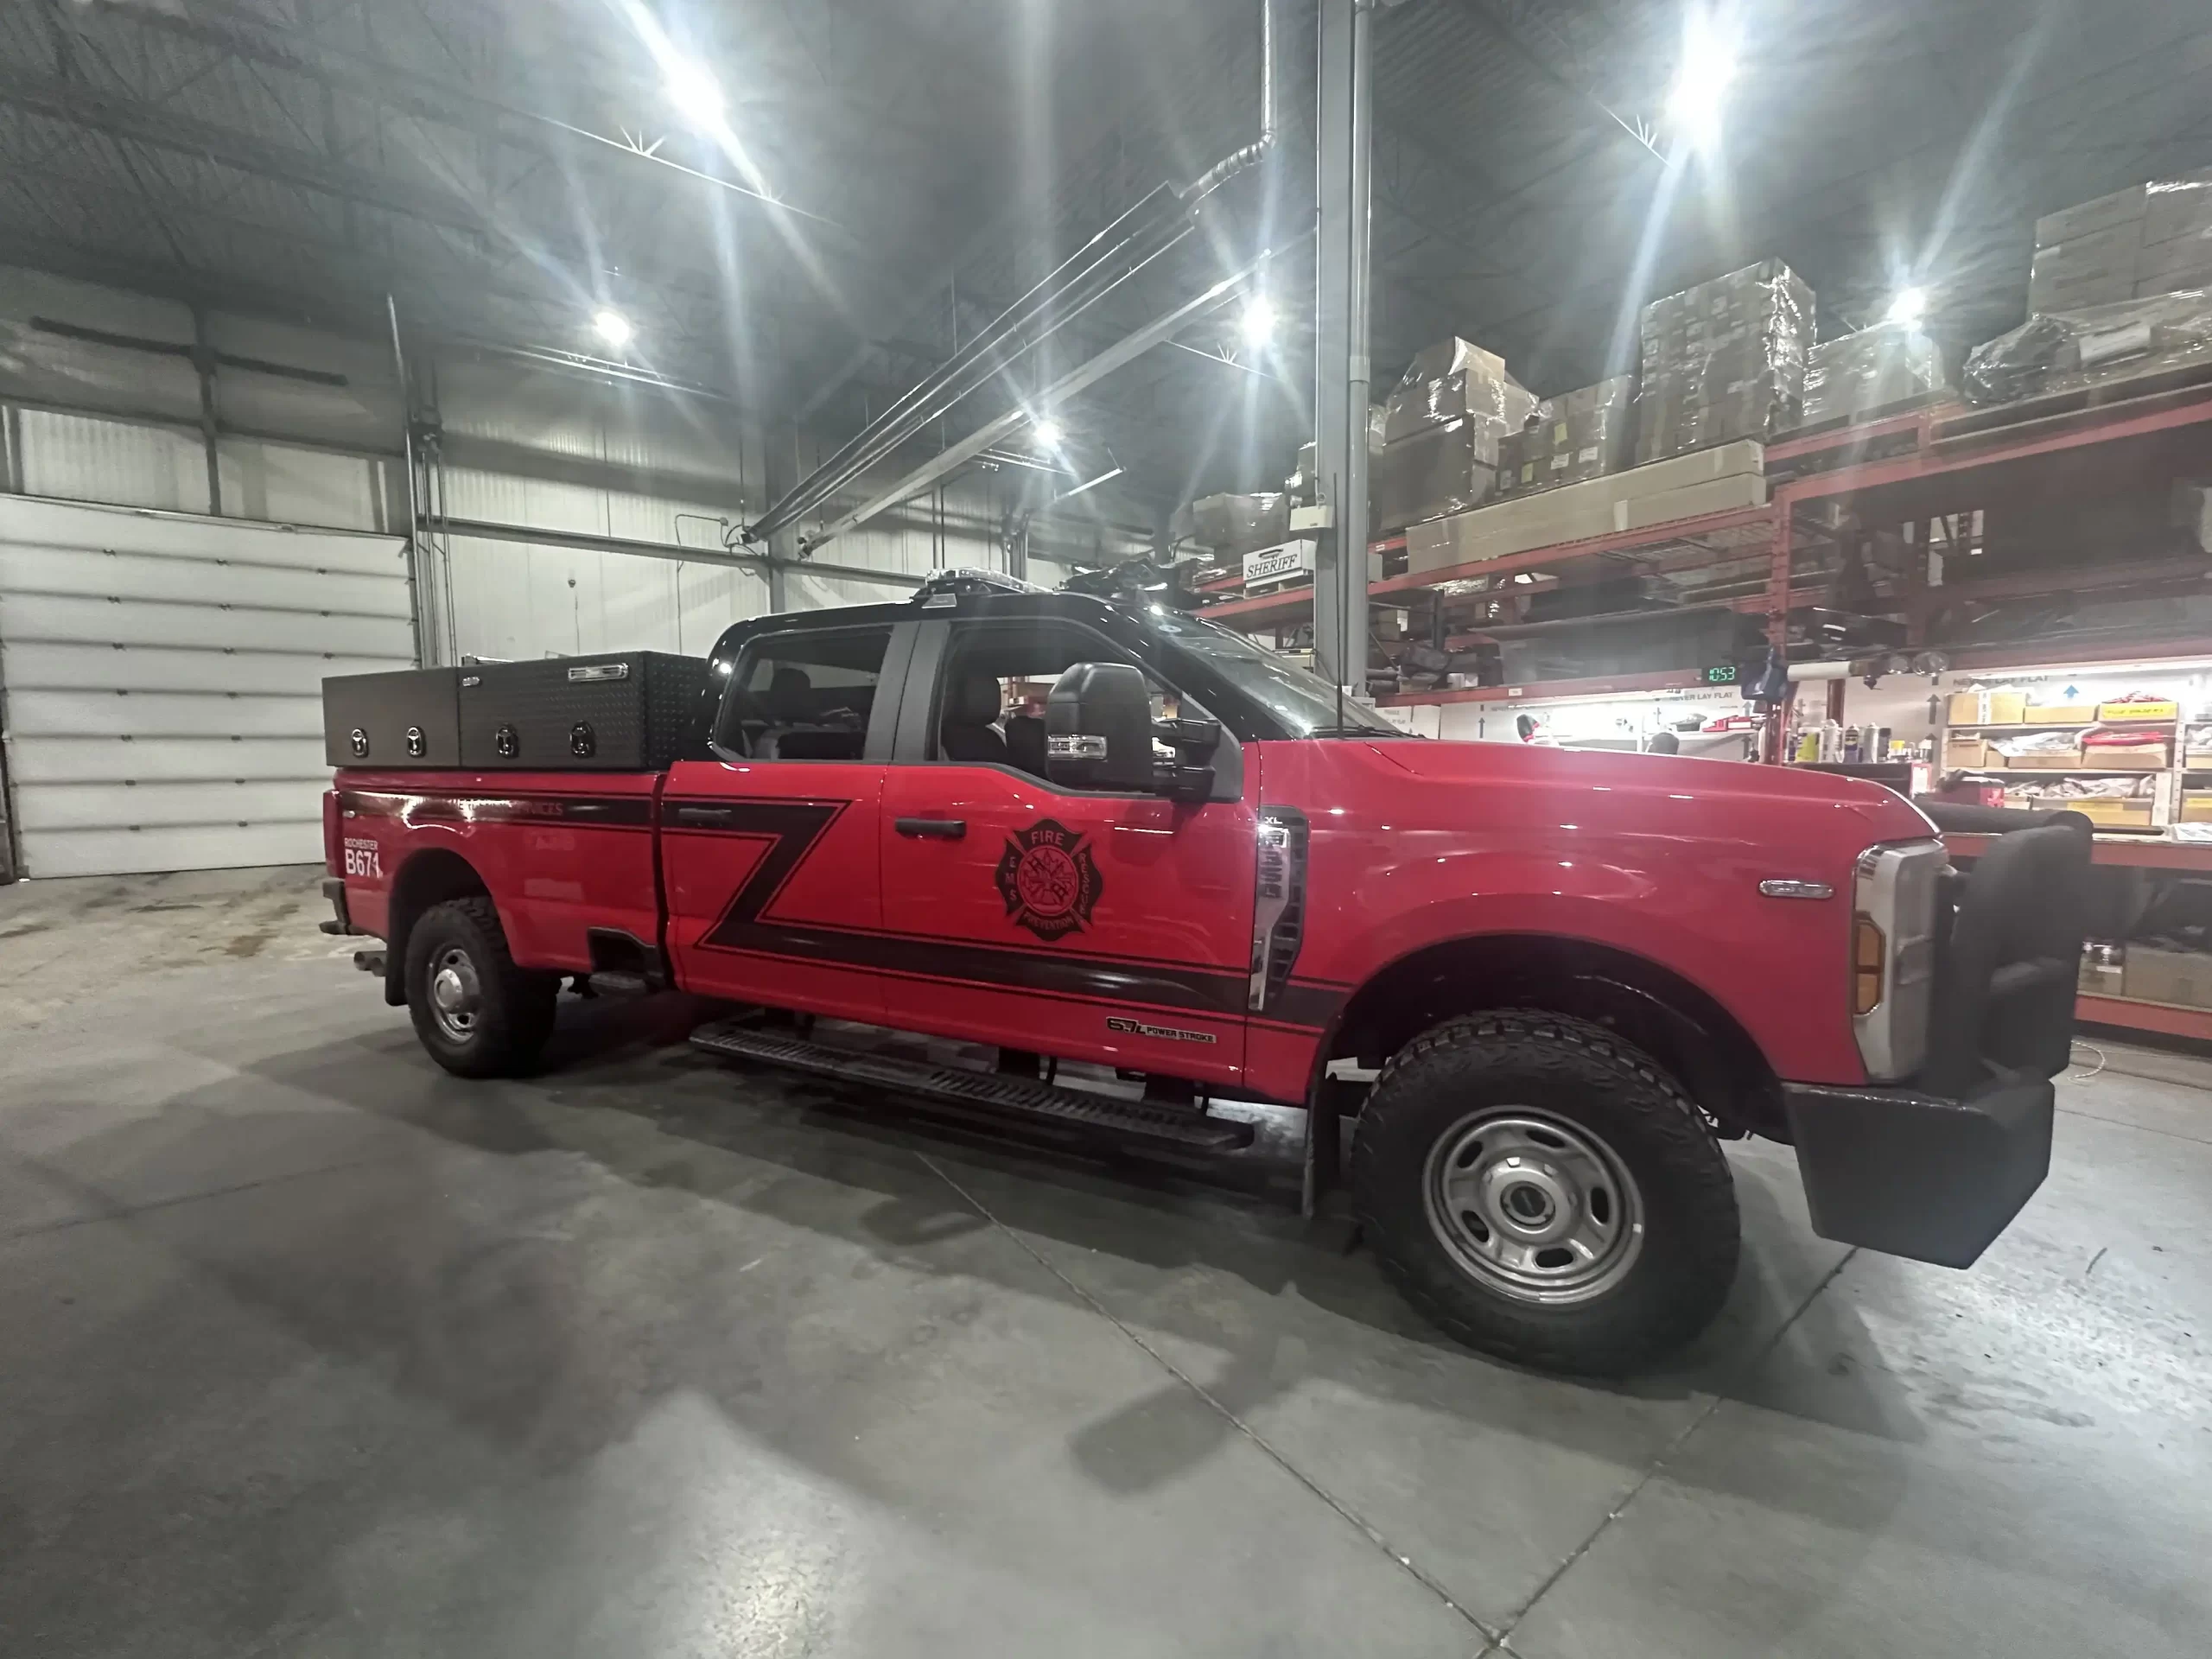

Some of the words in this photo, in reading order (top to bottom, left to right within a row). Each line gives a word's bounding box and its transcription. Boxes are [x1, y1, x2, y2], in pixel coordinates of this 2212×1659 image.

[1247, 554, 1297, 578] SHERIFF
[344, 837, 378, 850] ROCHESTER
[1031, 830, 1065, 846] FIRE
[1078, 853, 1090, 914] RESCUE
[1024, 912, 1074, 931] PREVENTION
[1106, 1017, 1146, 1034] 6.7L
[1147, 1026, 1177, 1037] POWER
[1179, 1031, 1214, 1042] STROKE
